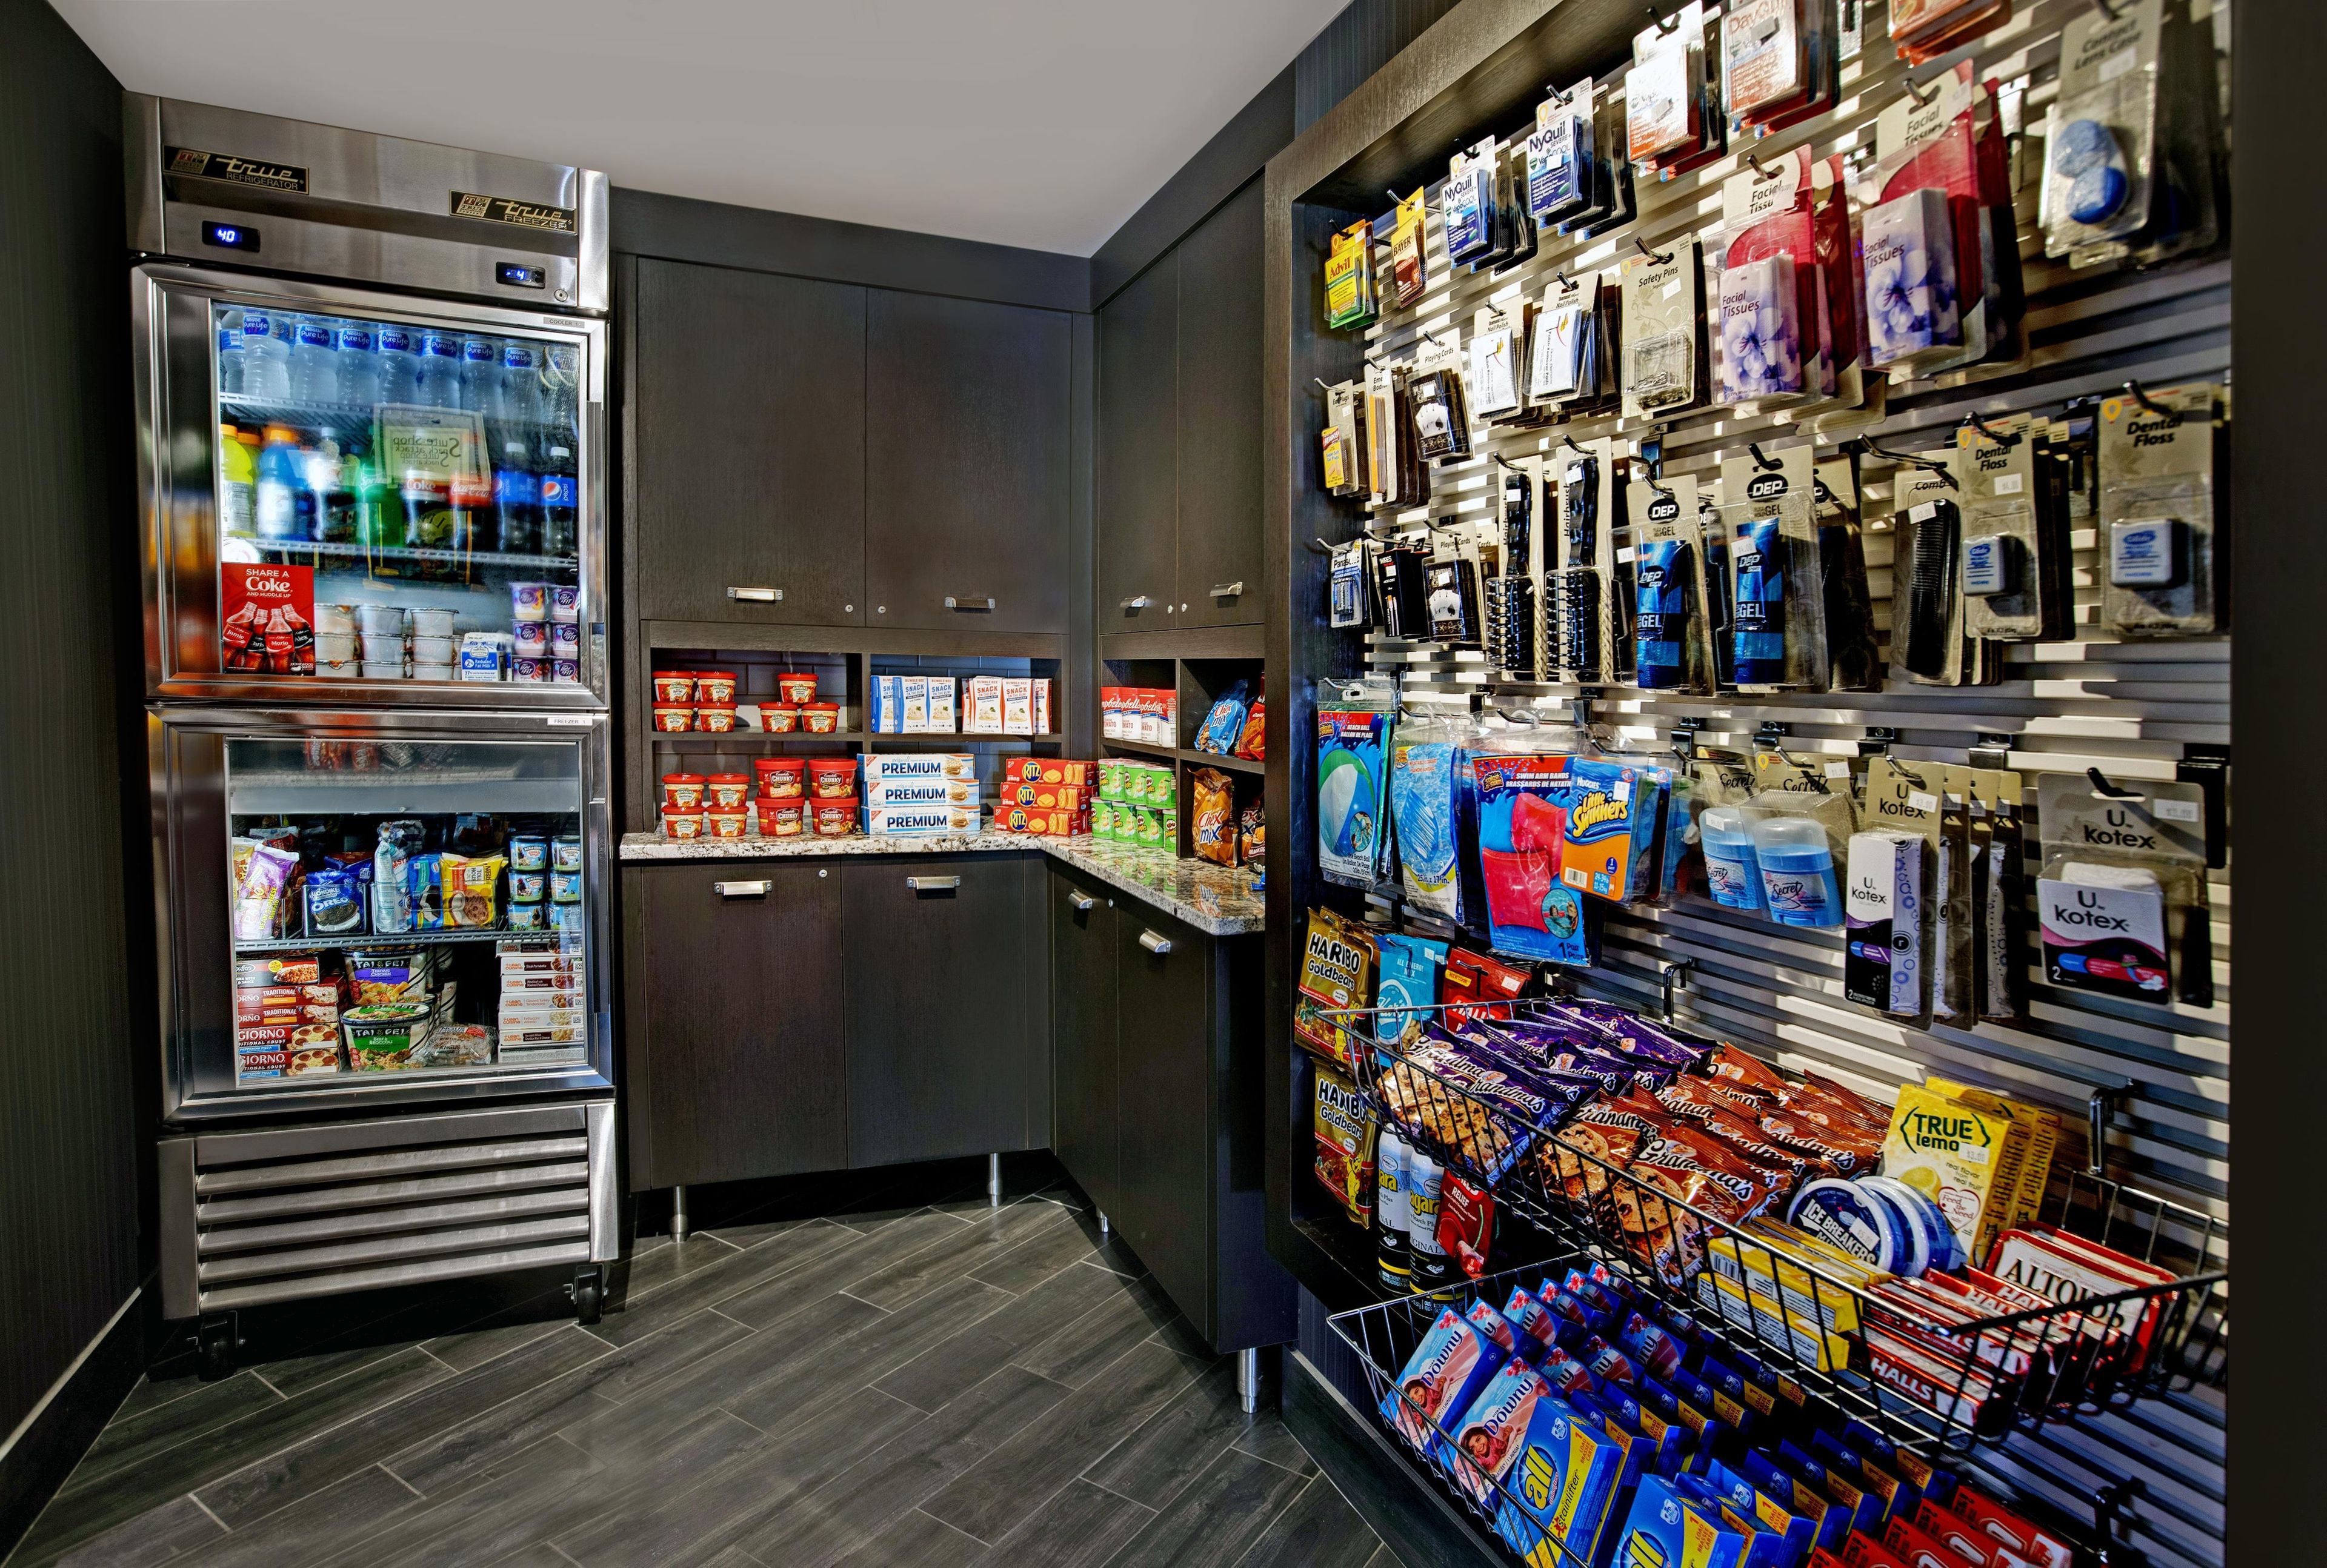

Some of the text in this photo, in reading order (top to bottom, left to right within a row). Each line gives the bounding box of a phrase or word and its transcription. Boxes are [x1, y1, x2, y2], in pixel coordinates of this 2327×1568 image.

[2082, 18, 2137, 54] Contact
[1906, 107, 1939, 136] Facial
[1529, 121, 1566, 153] NyQuil
[227, 173, 298, 190] REFRIGERATOR
[1444, 174, 1472, 202] NyQuil
[505, 214, 567, 230] FREEZER
[217, 229, 235, 243] 40
[1864, 234, 1889, 254] Facial
[1393, 236, 1412, 256] BAYER
[1865, 244, 1905, 268] Tissues
[1329, 256, 1351, 280] Advil
[1639, 265, 1679, 288] Safety Pins
[1722, 291, 1746, 305] Facial
[1722, 299, 1760, 318] Tissues
[396, 337, 409, 345] Life
[1425, 347, 1454, 363] Playing Cards
[2133, 431, 2175, 448] Floss
[1975, 446, 2011, 461] Dental
[1980, 457, 2008, 471] Floss
[407, 479, 436, 491] Coke
[1752, 479, 1783, 497] DEP
[1915, 479, 1948, 491] Comb
[1651, 505, 1677, 519] DEP
[1765, 503, 1783, 516] GEL
[1662, 527, 1676, 537] GEL
[1739, 554, 1760, 569] DEP
[245, 577, 291, 593] Coke
[1640, 570, 1662, 584] DEP
[1740, 603, 1765, 619] GEL
[1642, 614, 1662, 629] GEL
[227, 630, 245, 640] Jamie
[1214, 704, 1232, 718] Chex
[1211, 714, 1227, 728] mix
[882, 763, 941, 774] PREMIUM
[1024, 765, 1040, 780] RITZ
[1577, 777, 1600, 789] HUGGIES
[1720, 771, 1756, 789] Secret
[885, 788, 945, 800] PREMIUM
[1018, 788, 1034, 803] RITZ
[1879, 800, 1925, 819] kotex
[887, 816, 947, 828] PREMIUM
[1010, 813, 1026, 828] RITZ
[1198, 811, 1226, 828] Chex
[2107, 809, 2125, 828] U
[1200, 825, 1222, 845] mix
[2084, 824, 2154, 849] kotex
[1773, 881, 1803, 898] Secret
[1864, 876, 1873, 888] U
[1851, 884, 1886, 905] kotex
[2078, 889, 2097, 909] U
[258, 886, 278, 931] BEAN CHEESE
[311, 897, 350, 912] OREO
[2055, 906, 2128, 932] kotex
[1308, 931, 1360, 974] HARIBO
[1559, 942, 1566, 958] 1
[1566, 943, 1580, 952] Pair
[1307, 959, 1355, 992] Goldbears
[1320, 1106, 1363, 1141] Goldbears
[1915, 1114, 1973, 1141] TRUE
[1966, 1148, 1986, 1163] $3.00
[1946, 1161, 1980, 1179] real flavor
[1955, 1170, 1968, 1179] from
[1953, 1175, 1983, 1192] real fruit
[1451, 1186, 1470, 1207] RELIEF
[1942, 1192, 1963, 1206] Feed
[1953, 1207, 1975, 1220] Need
[1803, 1198, 1877, 1264] ICE BREAKERS
[1420, 1329, 1463, 1387] Downy
[1870, 1357, 1934, 1401] HALLS
[1483, 1377, 1535, 1437] Downy
[1524, 1443, 1555, 1510] all
[1695, 1523, 1704, 1540] LOAD
[1703, 1529, 1715, 1550] CARTA
